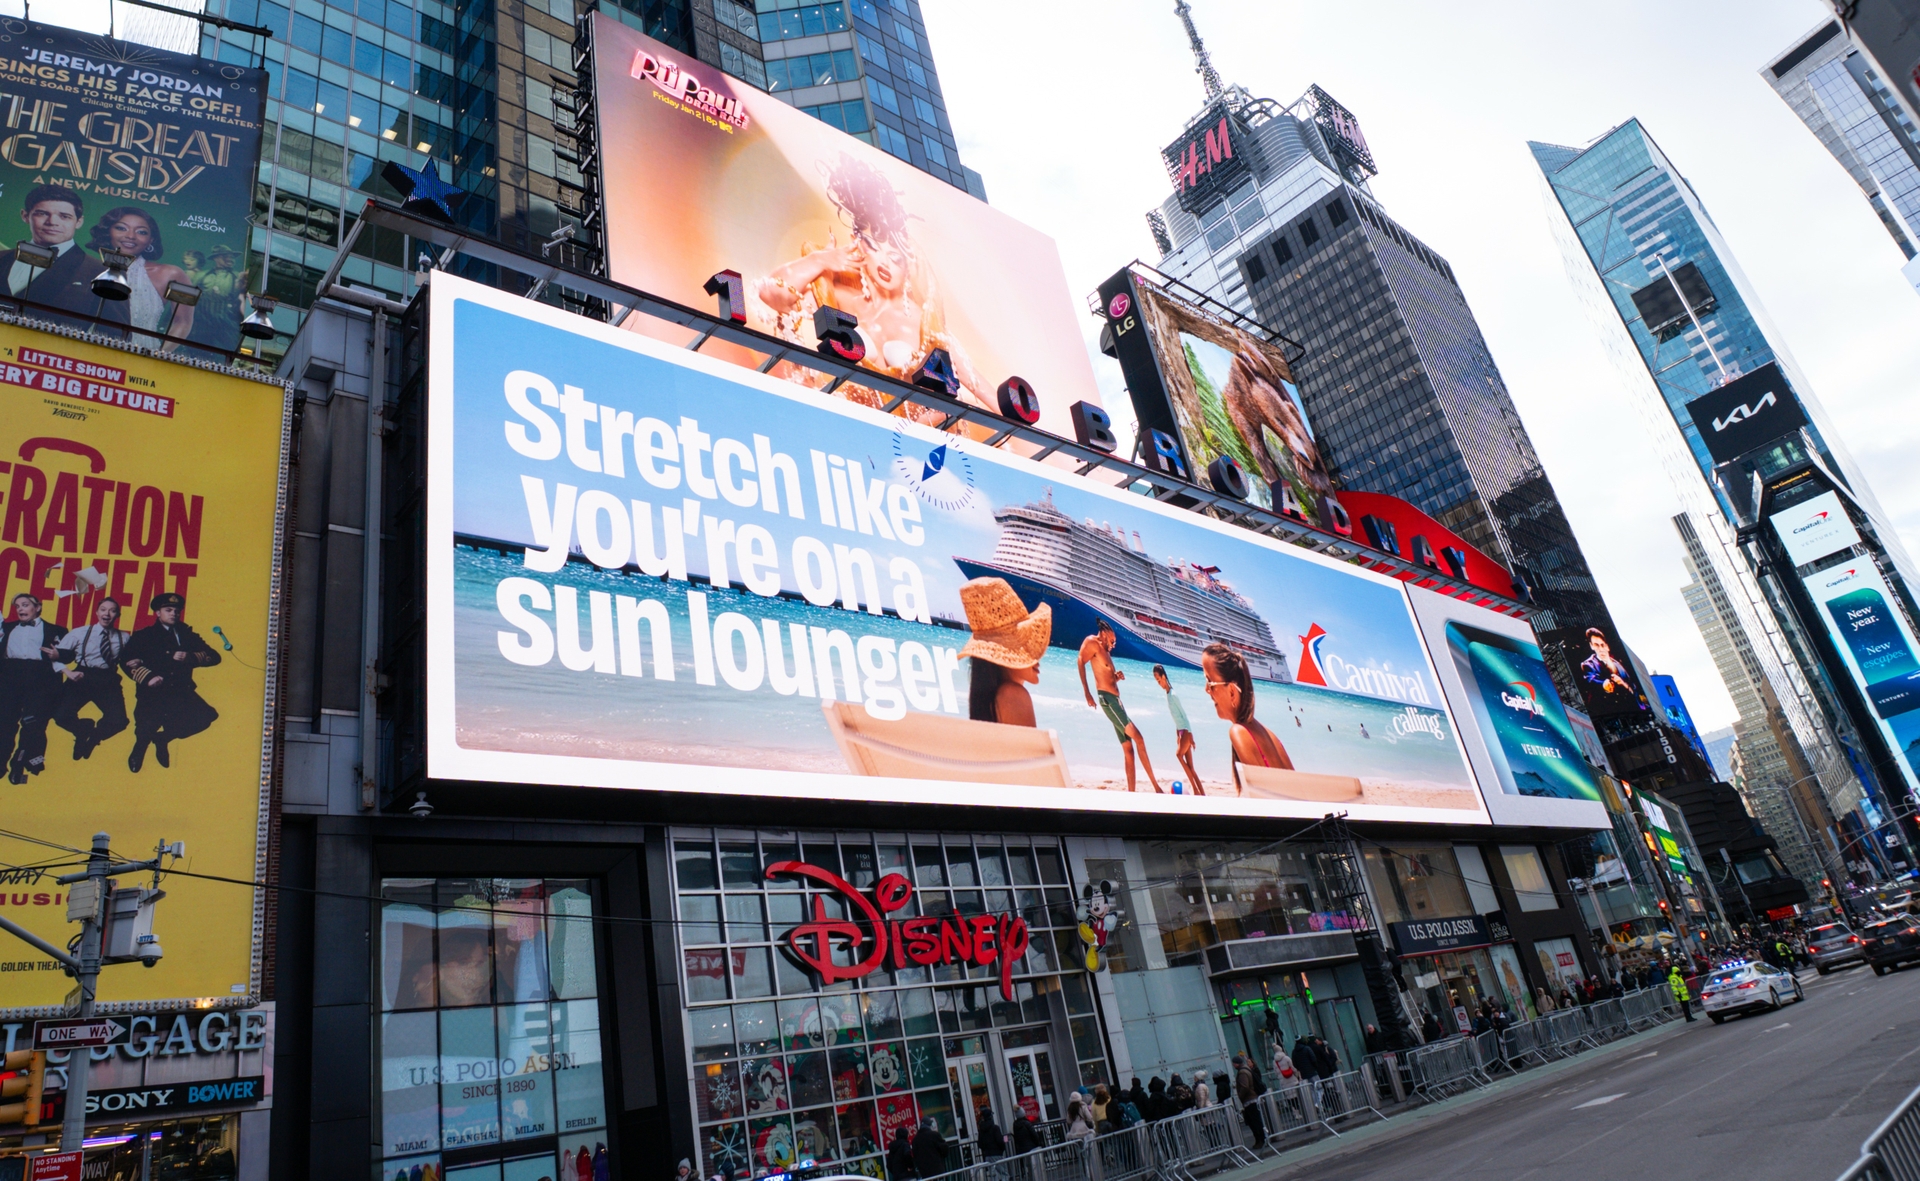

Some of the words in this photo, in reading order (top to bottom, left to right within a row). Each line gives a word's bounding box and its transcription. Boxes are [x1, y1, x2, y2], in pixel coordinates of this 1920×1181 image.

[0, 57, 70, 82] SINGS
[78, 73, 117, 92] HIS
[125, 83, 183, 105] FACE
[190, 97, 241, 117] OFF!
[0, 72, 37, 85] VOICE
[40, 80, 79, 94] SOARS
[83, 88, 99, 97] TO
[102, 92, 125, 103] THE
[128, 97, 159, 110] BACK
[162, 105, 178, 113] OF
[181, 108, 203, 118] THE
[127, 69, 222, 99] JORDAN
[81, 97, 114, 109] Chicago
[116, 102, 148, 115] Tribune
[653, 90, 679, 109] Friday
[681, 104, 695, 115] Jan
[685, 95, 718, 116] DRAG
[719, 111, 748, 130] RACE
[78, 111, 240, 168] GREAT
[1, 133, 206, 194] GATSBY
[1176, 117, 1233, 194] H&M
[32, 174, 46, 185] A
[50, 177, 91, 191] NEW
[94, 184, 170, 206] MUSICAL
[177, 219, 226, 233] JACKSON
[187, 214, 218, 225] AISHA
[1115, 315, 1135, 337] LG
[23, 350, 73, 371] LITTLE
[75, 362, 122, 381] SHOW
[129, 375, 149, 386] WITH
[150, 380, 156, 388] A
[42, 373, 82, 396] BIG
[504, 369, 805, 521] Stretch
[810, 447, 925, 547] like
[0, 461, 204, 559] RATION
[520, 474, 781, 597] you're
[793, 535, 884, 617] on
[888, 555, 933, 625] a
[1801, 532, 1833, 547] VENTURE
[1847, 606, 1872, 620] New
[1851, 615, 1879, 631] year.
[496, 576, 676, 681] sun
[686, 591, 960, 721] lounger
[1863, 650, 1907, 669] escapes.
[1866, 642, 1891, 656] New
[1325, 653, 1432, 706] Carnival
[1391, 706, 1445, 741] calling
[1521, 743, 1554, 758] VENTURE
[1656, 728, 1677, 764] 1500
[1408, 924, 1427, 940] U.S.
[1425, 921, 1452, 939] POLO
[1451, 919, 1478, 935] ASSN.
[1, 961, 34, 972] GOLDEN
[48, 1028, 77, 1040] ONE
[89, 1025, 118, 1037] WAY
[410, 1064, 448, 1086] U.S.
[457, 1057, 516, 1081] POLO
[523, 1052, 580, 1074] ASSN.
[85, 1088, 174, 1113] SONY
[188, 1081, 255, 1104] BOWER
[462, 1083, 502, 1099] SINCE
[506, 1079, 536, 1093] 1890
[515, 1123, 545, 1135] MILAN
[565, 1117, 597, 1129] BERLIN
[879, 1107, 912, 1130] Season
[395, 1140, 427, 1152] MIAMI
[446, 1130, 498, 1146] SHANGHAI
[35, 1158, 45, 1166] NO
[46, 1154, 76, 1165] STANDING
[35, 1165, 61, 1174] Anytime
